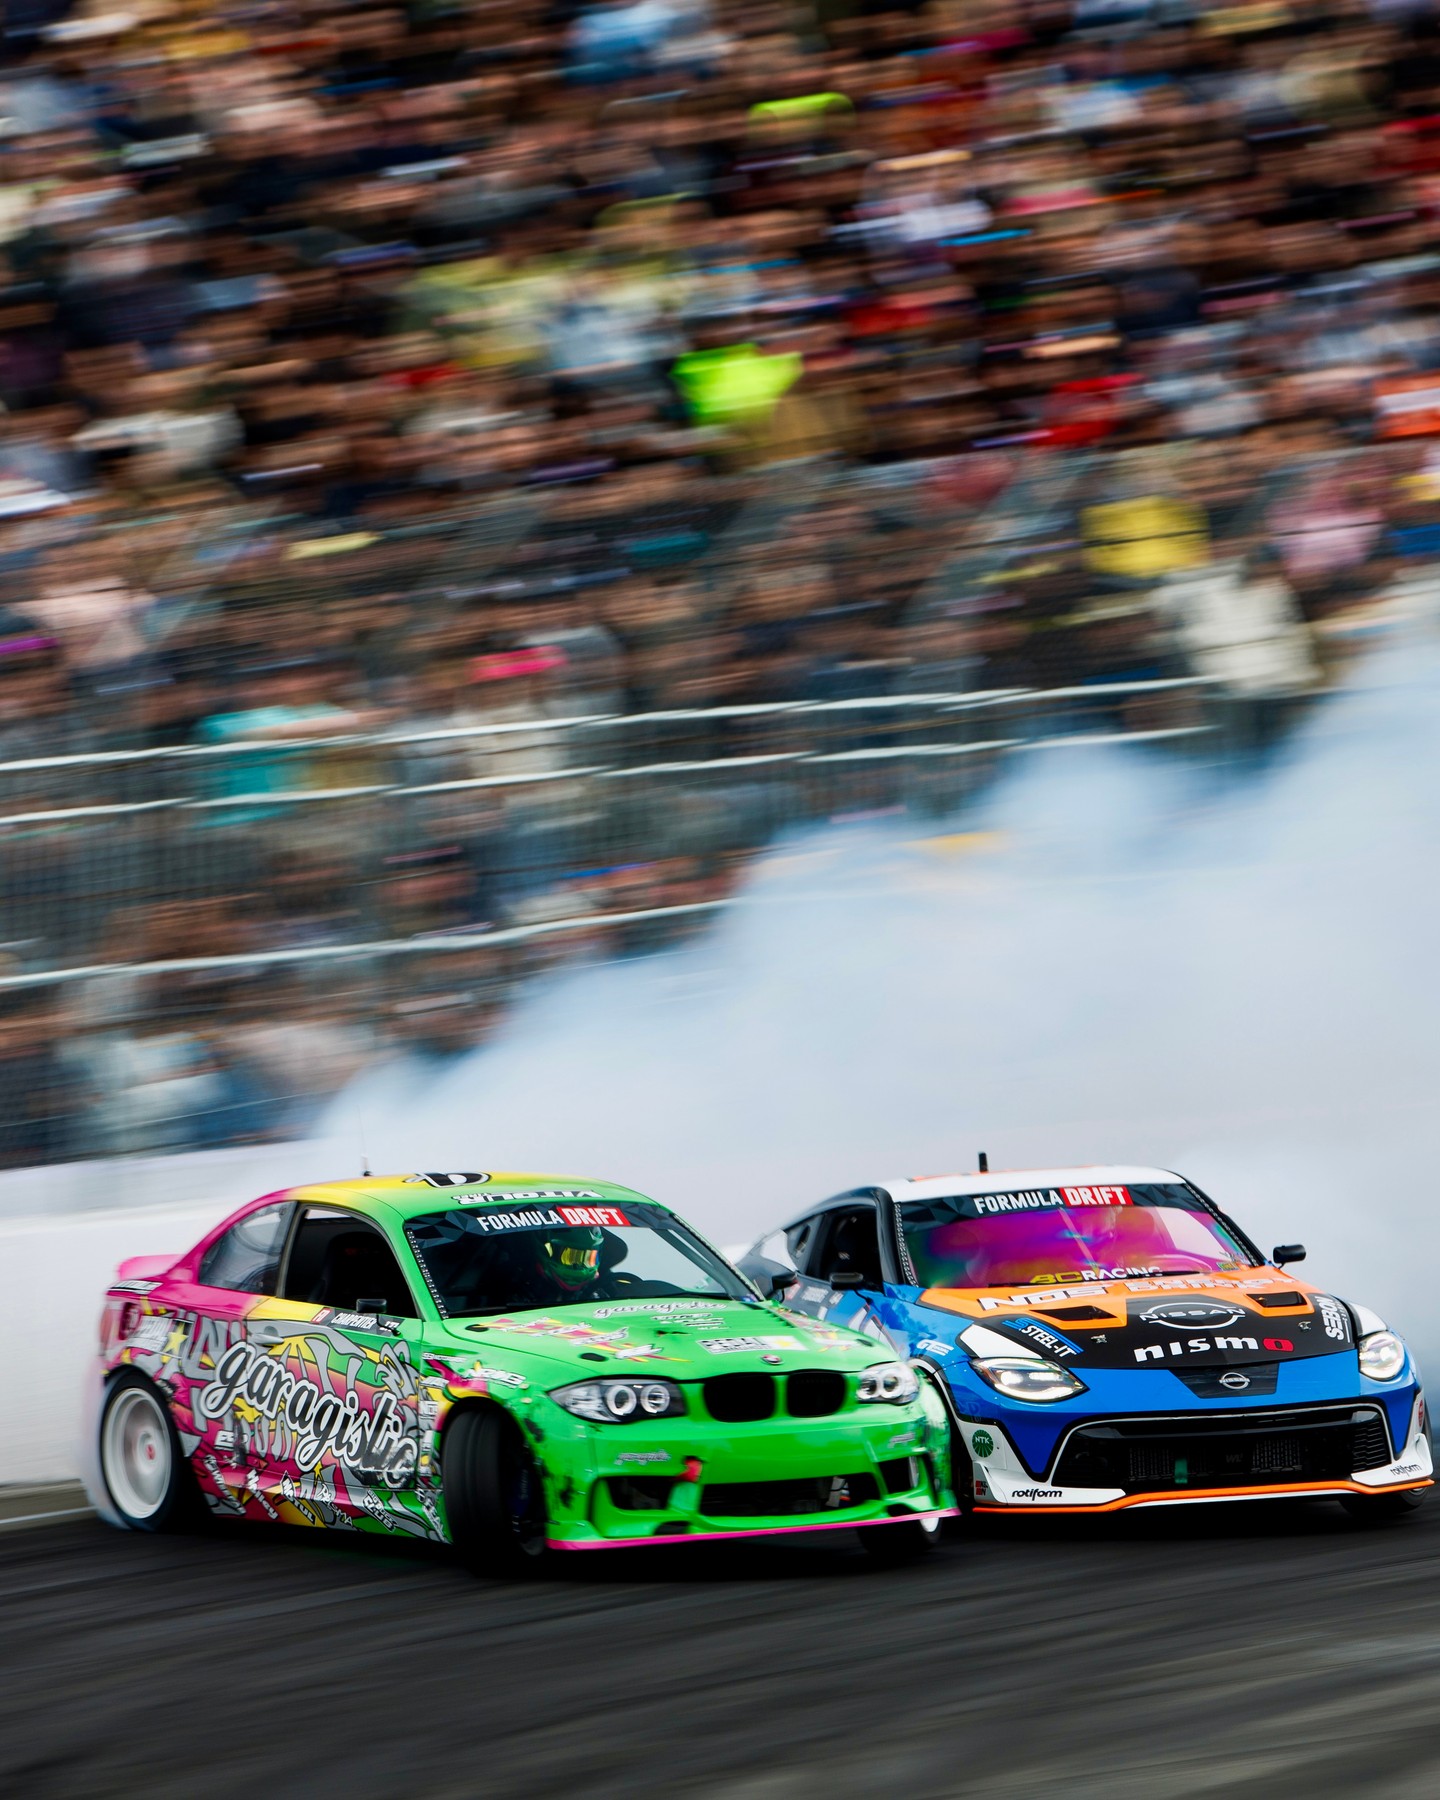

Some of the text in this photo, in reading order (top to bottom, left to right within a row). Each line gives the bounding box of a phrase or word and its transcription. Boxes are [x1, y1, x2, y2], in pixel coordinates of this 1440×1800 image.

[973, 1186, 1127, 1214] FORMULA DRIFT
[477, 1208, 626, 1232] FORMULA DRIFT
[978, 1286, 1109, 1311] NOS
[1139, 1308, 1246, 1322] NISSAN
[1021, 1325, 1078, 1358] STEEL-IT
[1133, 1336, 1294, 1362] nismo
[200, 1340, 419, 1489] garagistic
[974, 1436, 990, 1445] NTK
[282, 1477, 316, 1523] MOTUL
[1011, 1488, 1063, 1501] rotiform
